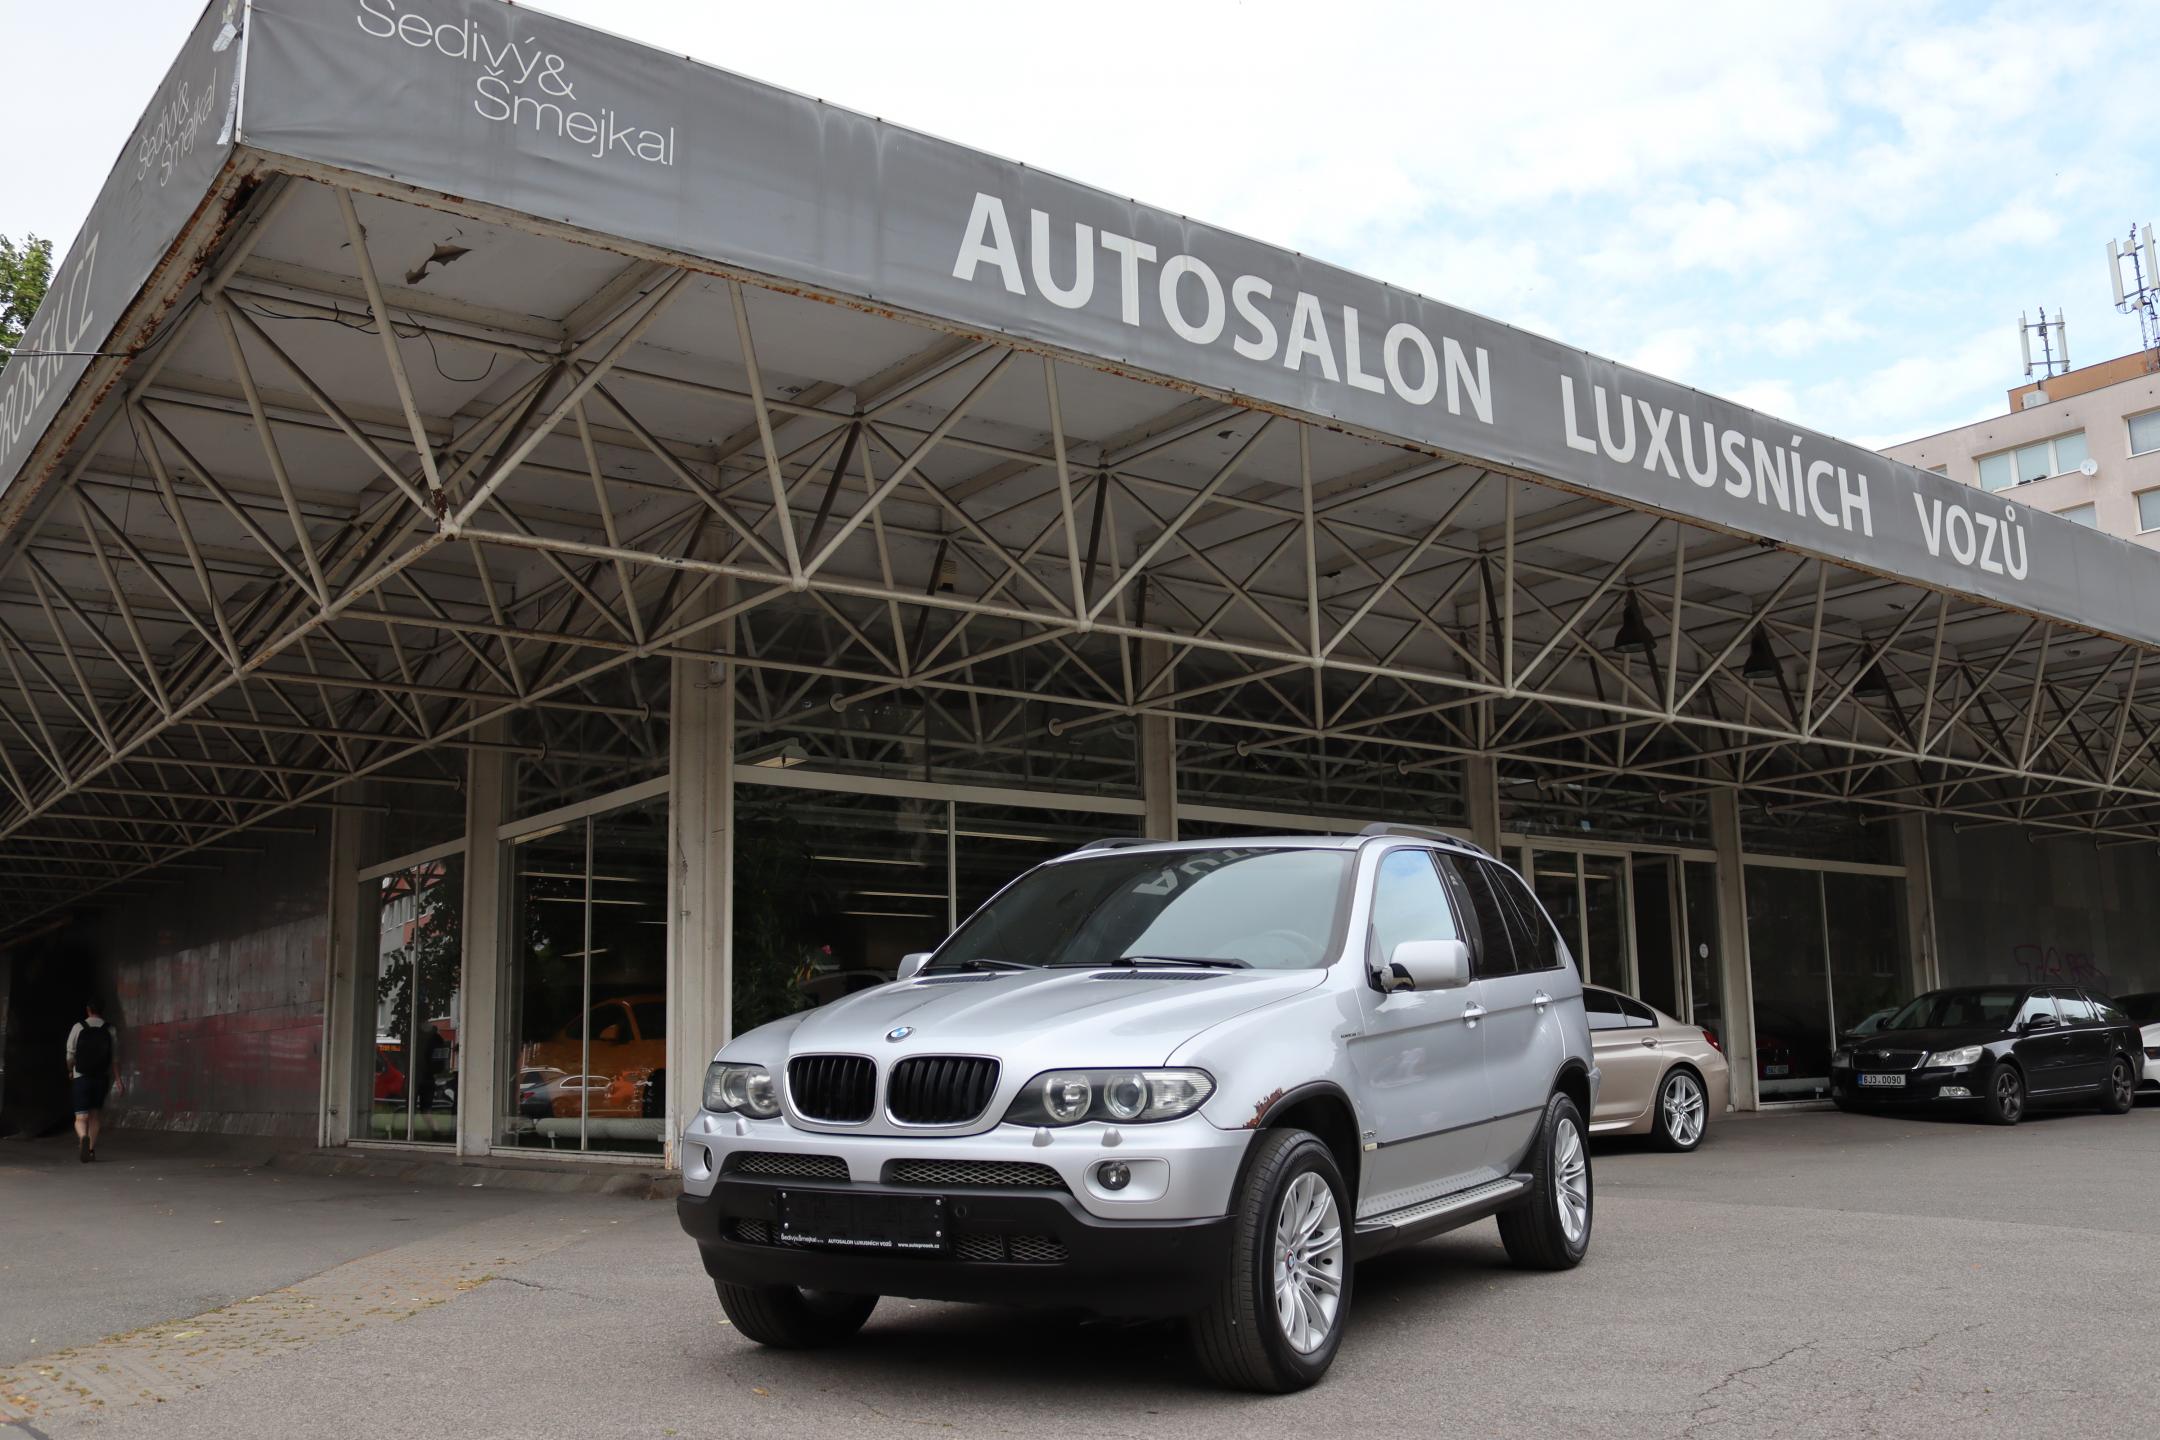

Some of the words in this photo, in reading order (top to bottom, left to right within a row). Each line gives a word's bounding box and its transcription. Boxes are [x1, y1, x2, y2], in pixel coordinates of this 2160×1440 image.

[474, 65, 675, 166] Šmejkal
[951, 191, 1494, 425] AUTOSALON
[1560, 374, 1874, 538] LUXUSNÍCH
[1912, 492, 2029, 581] VOZŮ
